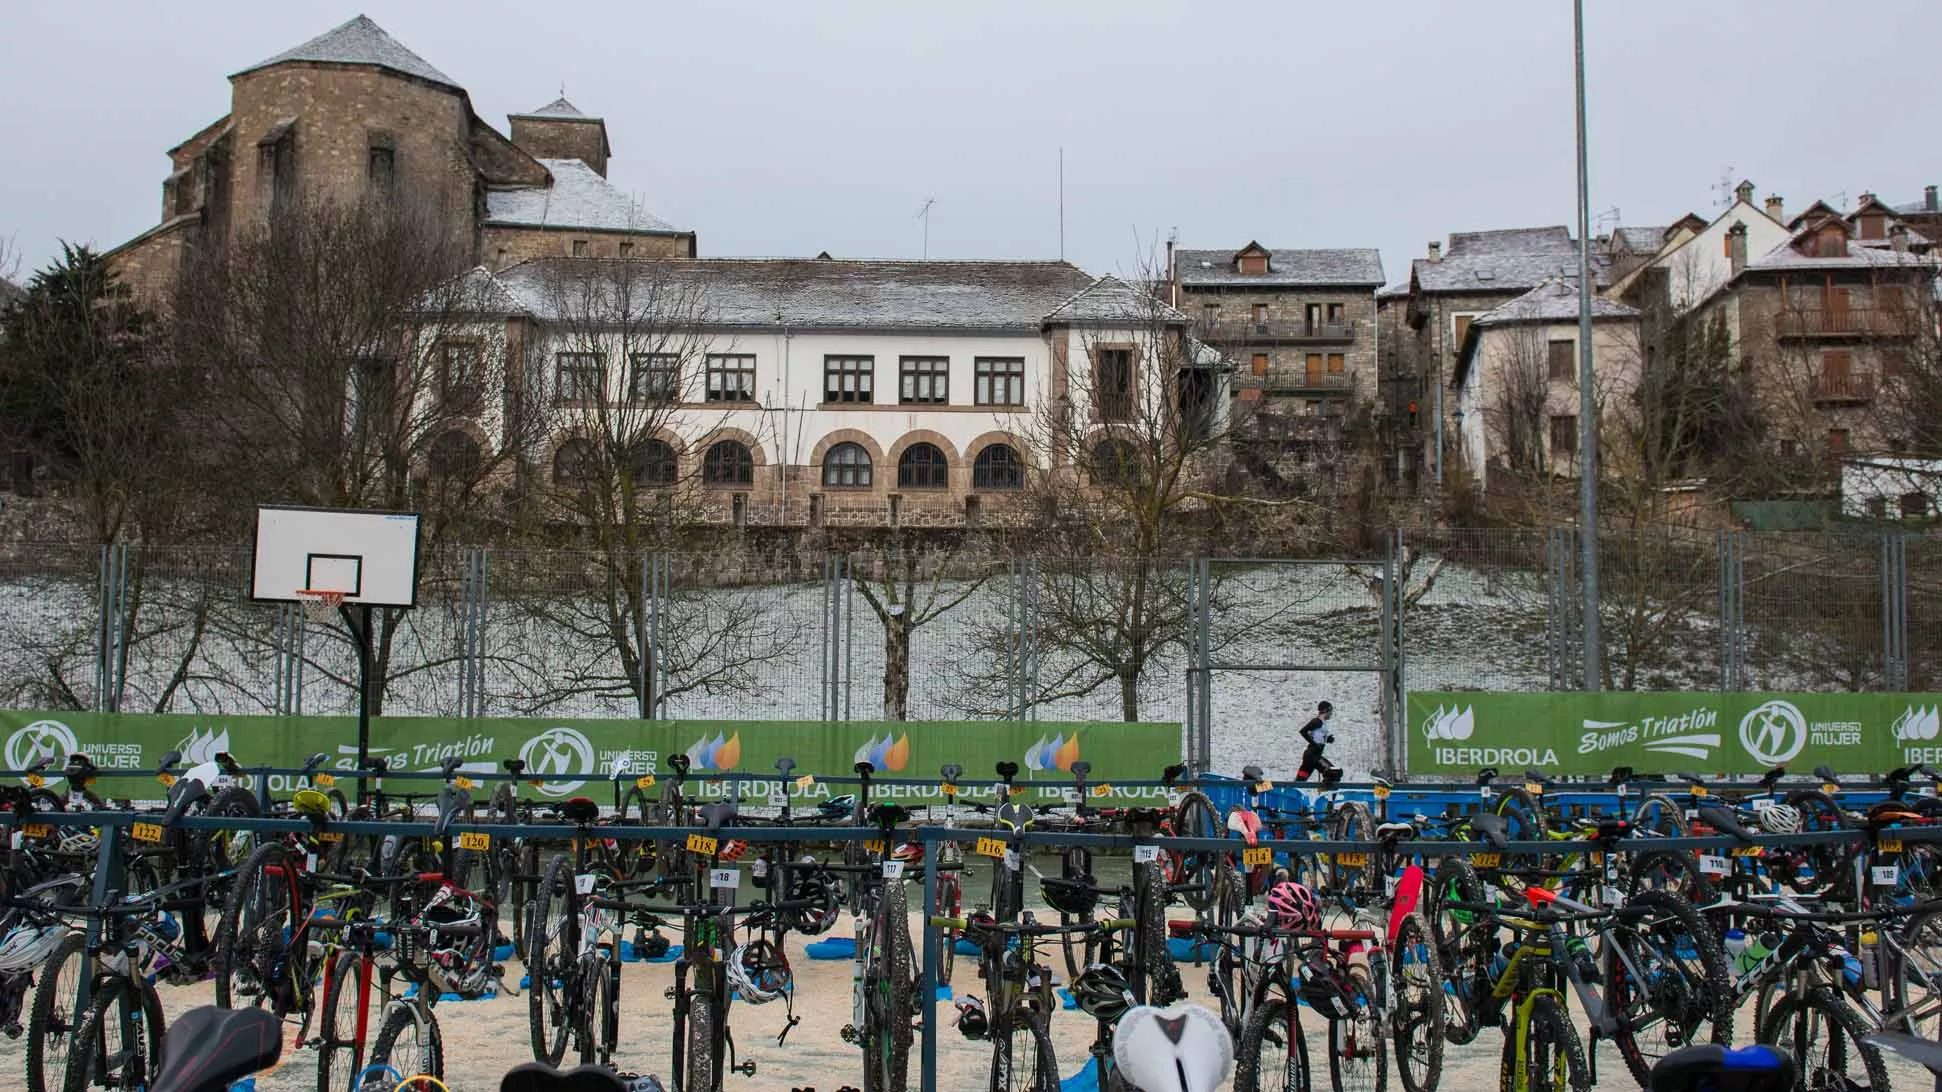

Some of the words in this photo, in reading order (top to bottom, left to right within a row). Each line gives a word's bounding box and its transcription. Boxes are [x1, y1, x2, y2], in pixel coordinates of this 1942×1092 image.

[1578, 726, 1638, 754] Somos
[1641, 707, 1717, 738] Triatlón
[1810, 721, 1861, 732] UNIVERSO
[1811, 732, 1861, 745] MUJER
[83, 743, 142, 754] UNIVERSO
[1435, 747, 1560, 766] IBERDROLA
[139, 827, 156, 838] 122
[466, 836, 484, 847] 120
[693, 839, 712, 851] 118
[983, 841, 1000, 854] 116
[1249, 852, 1266, 862] 114
[134, 926, 184, 962] FOCUS
